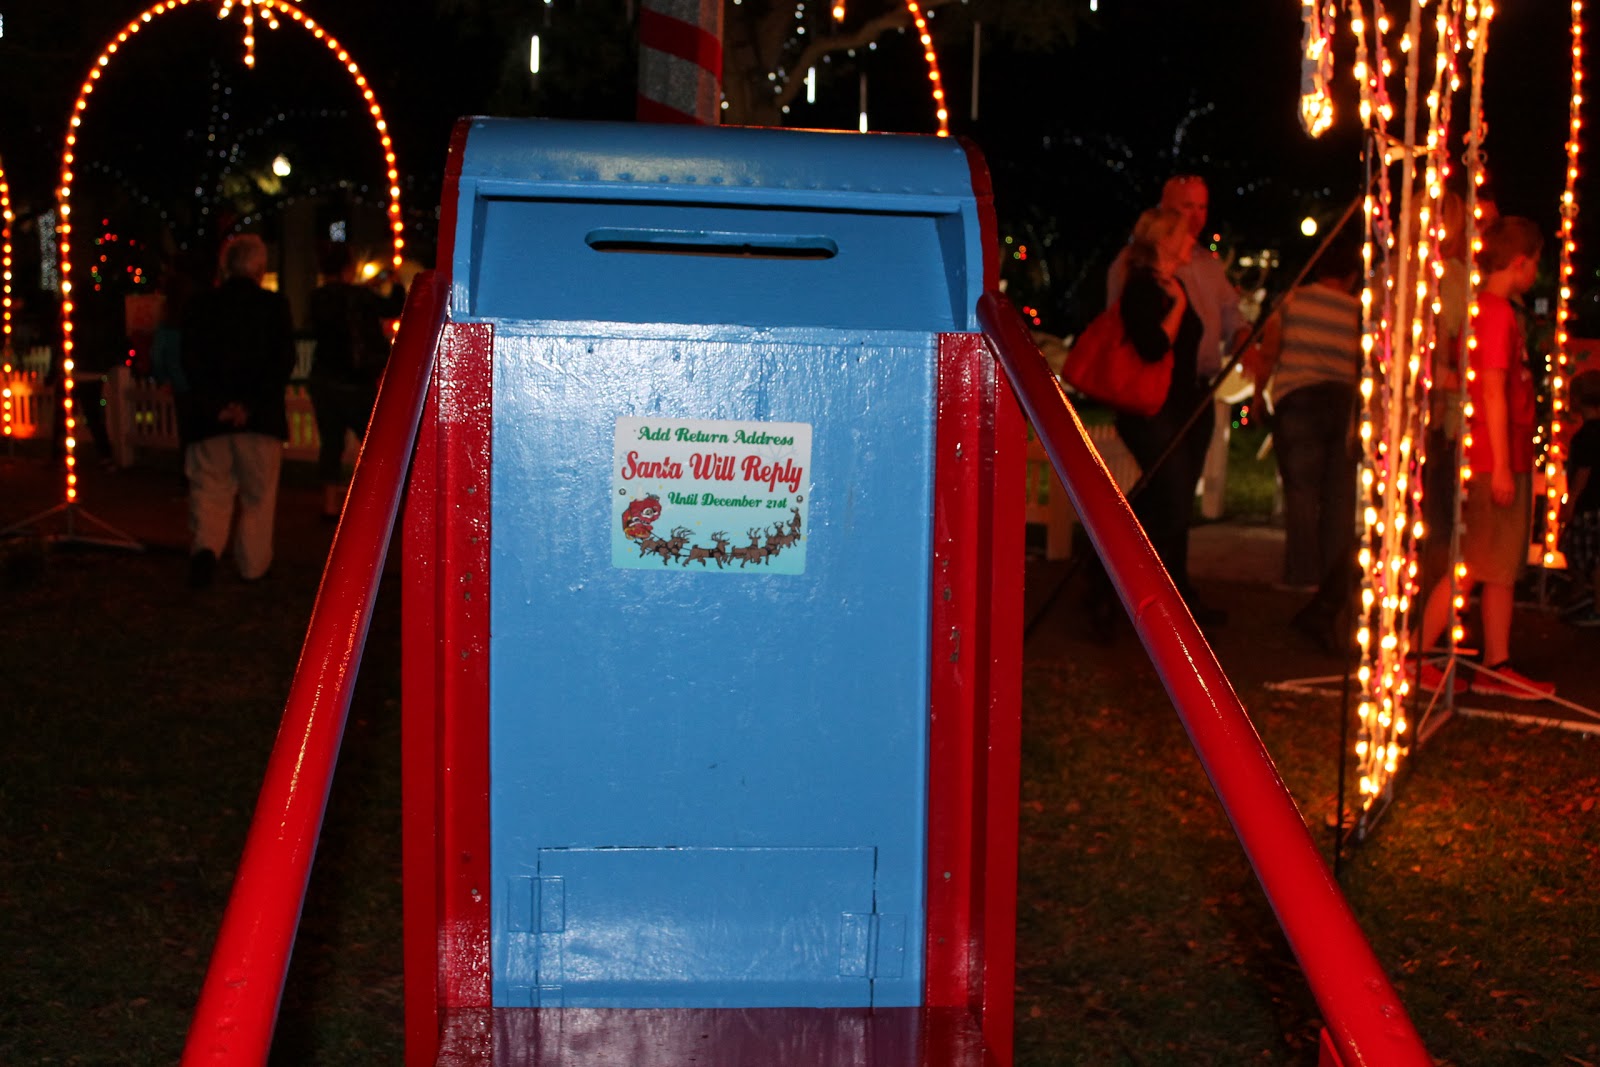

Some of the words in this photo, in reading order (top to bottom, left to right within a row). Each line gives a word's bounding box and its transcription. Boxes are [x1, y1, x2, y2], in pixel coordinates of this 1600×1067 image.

[637, 426, 671, 441] Add
[674, 427, 729, 444] Return
[732, 429, 794, 446] Address
[621, 450, 683, 481] Santa
[689, 452, 736, 482] Will
[741, 455, 803, 493] Reply
[668, 491, 698, 506] Until
[701, 493, 762, 508] December
[766, 497, 788, 509] 21st
